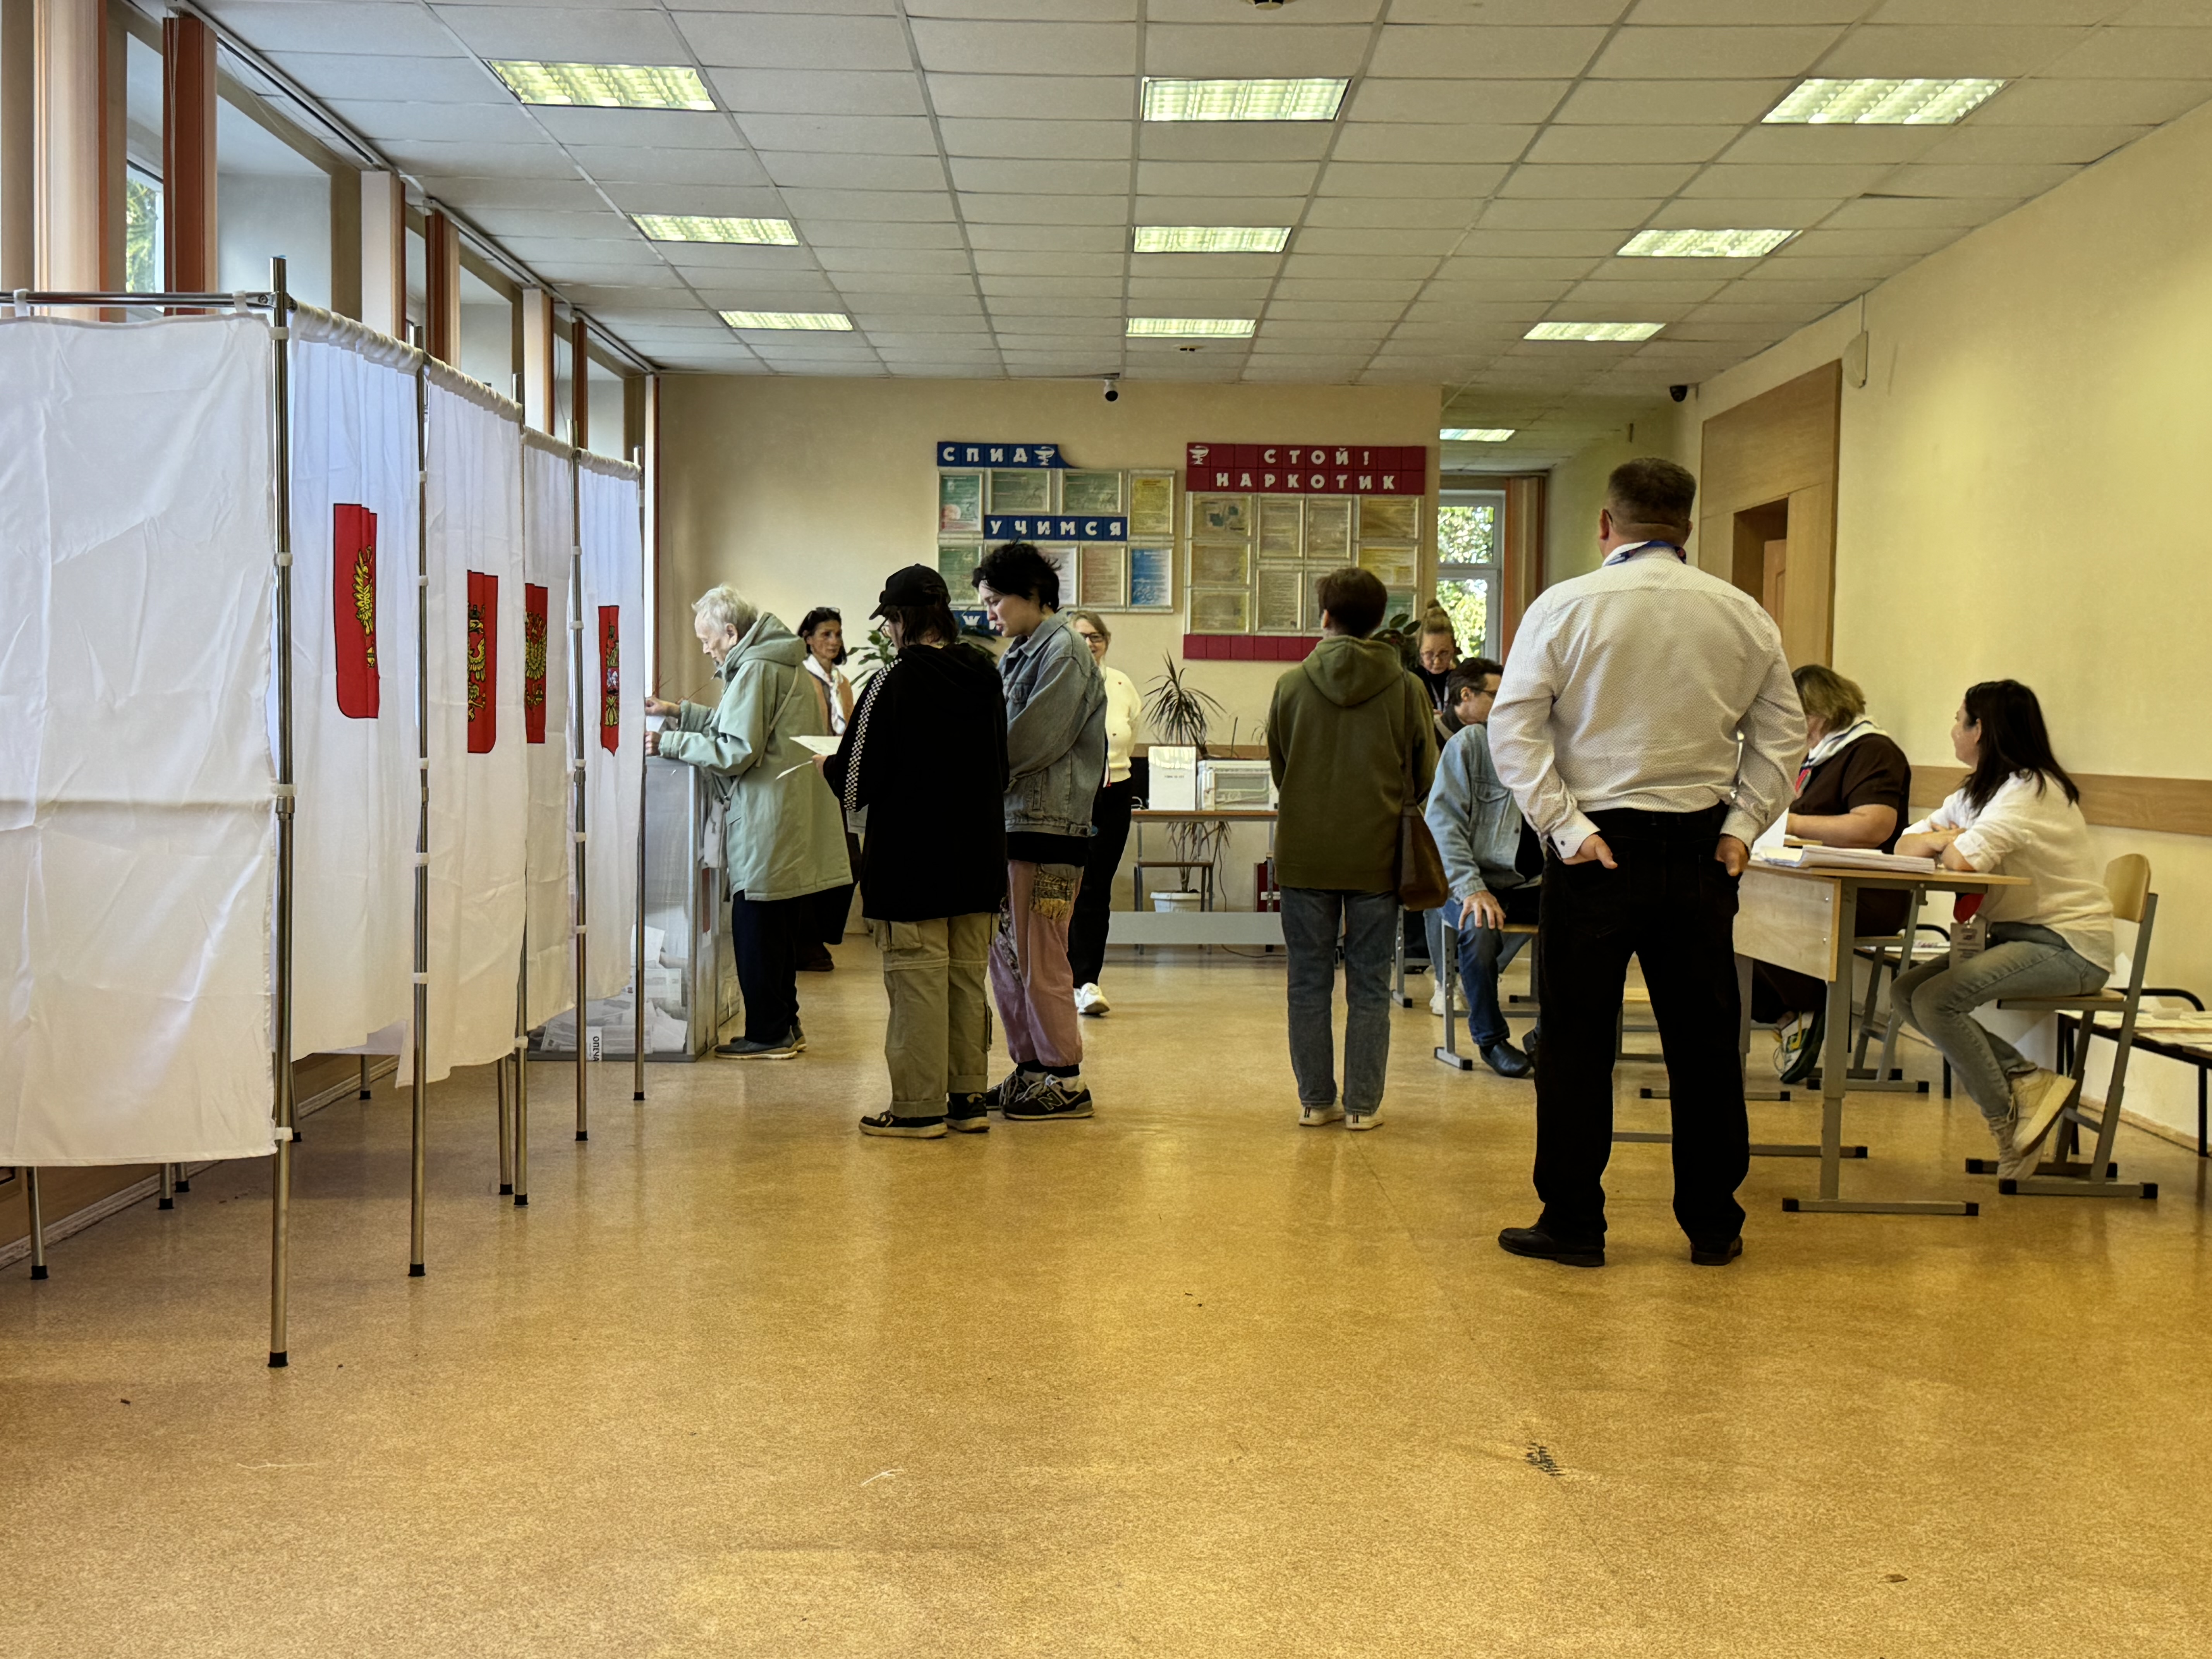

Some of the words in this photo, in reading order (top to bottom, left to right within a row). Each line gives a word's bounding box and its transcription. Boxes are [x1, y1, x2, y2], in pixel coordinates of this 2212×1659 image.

[943, 447, 1028, 463] СПИД
[1264, 448, 1369, 465] СТОЙ!
[1216, 472, 1395, 490] НАРКОТИК
[990, 520, 1121, 536] УЧИМСЯ
[1037, 1092, 1063, 1111] N
